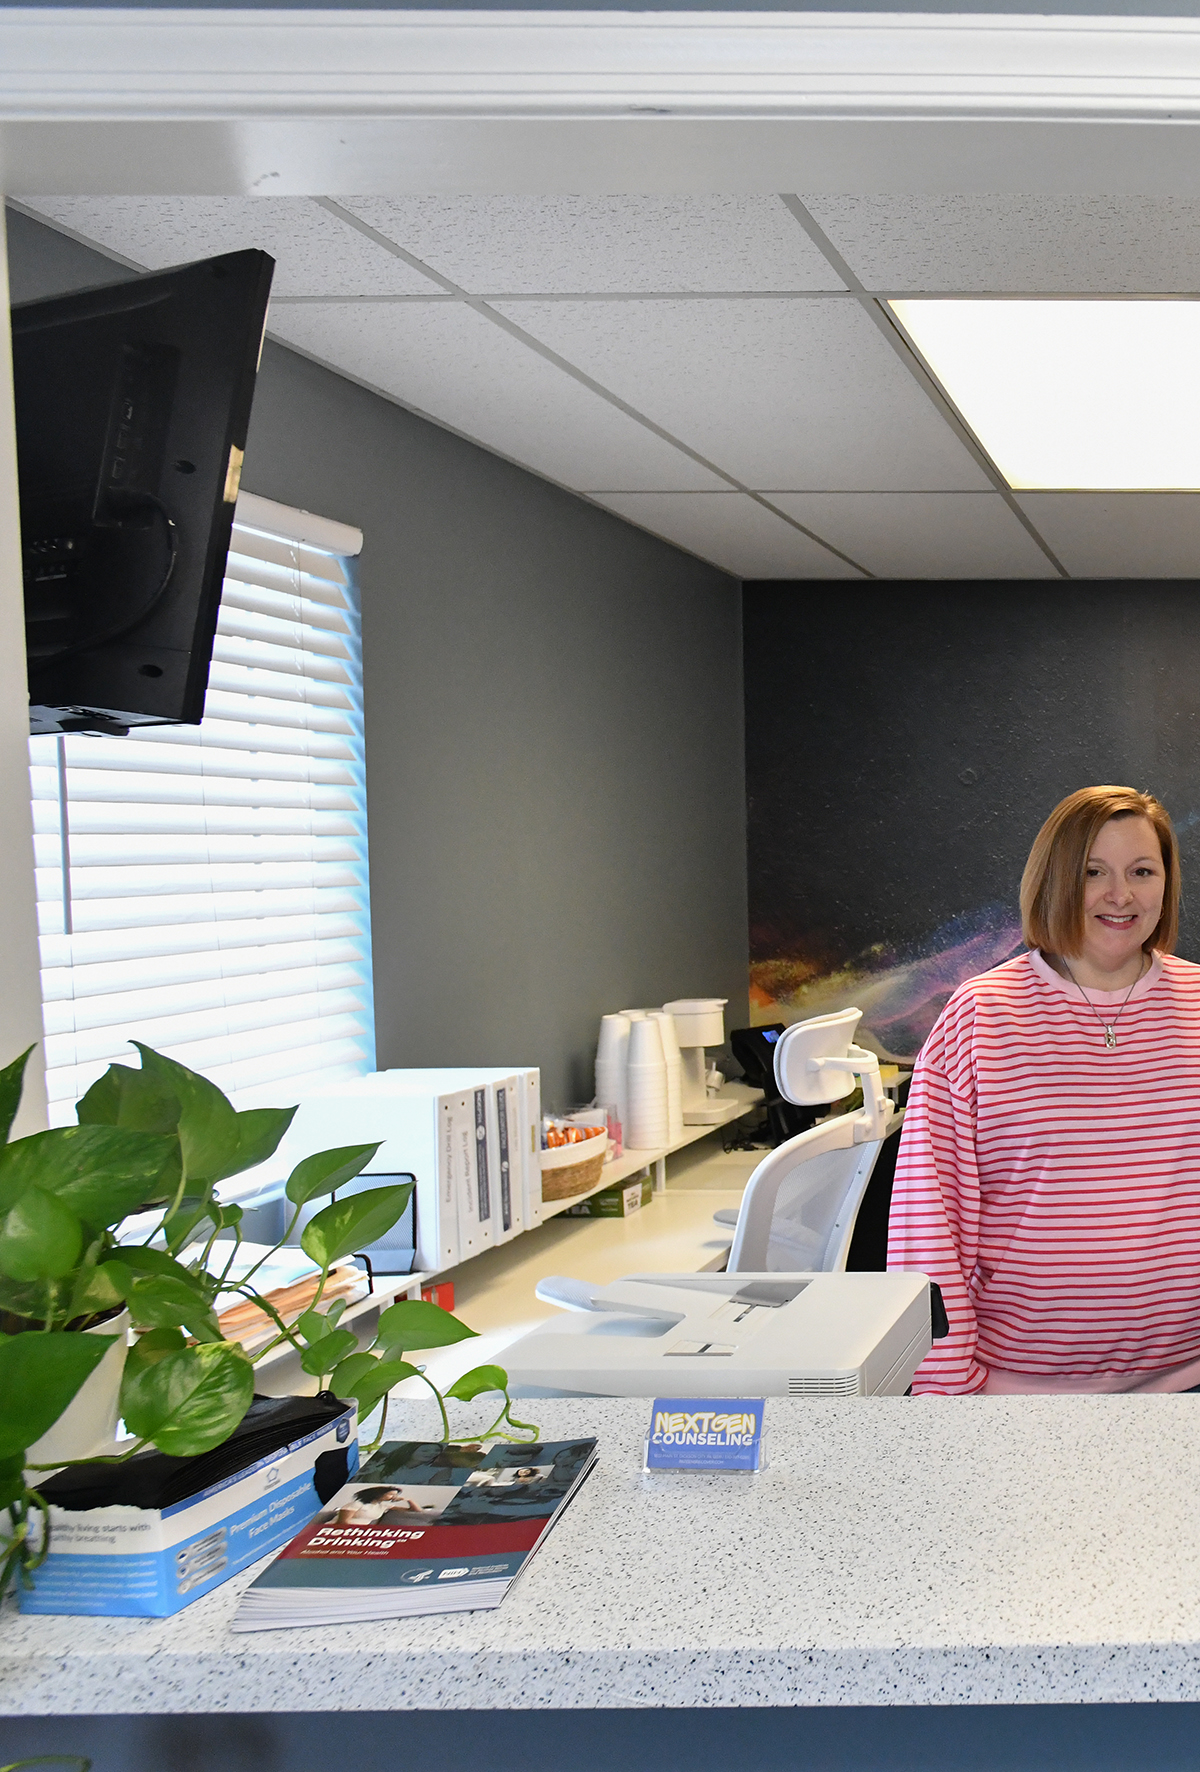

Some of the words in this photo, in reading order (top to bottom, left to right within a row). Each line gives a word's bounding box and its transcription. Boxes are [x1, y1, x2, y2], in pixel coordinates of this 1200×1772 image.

[654, 1412, 756, 1435] NEXTGEN
[652, 1432, 753, 1446] COUNSELING
[229, 1507, 268, 1536] Premium
[268, 1482, 311, 1513] Disposable
[249, 1521, 269, 1539] Face
[269, 1506, 295, 1528] Masks
[316, 1527, 425, 1540] Rethinking
[307, 1537, 396, 1549] Drinking
